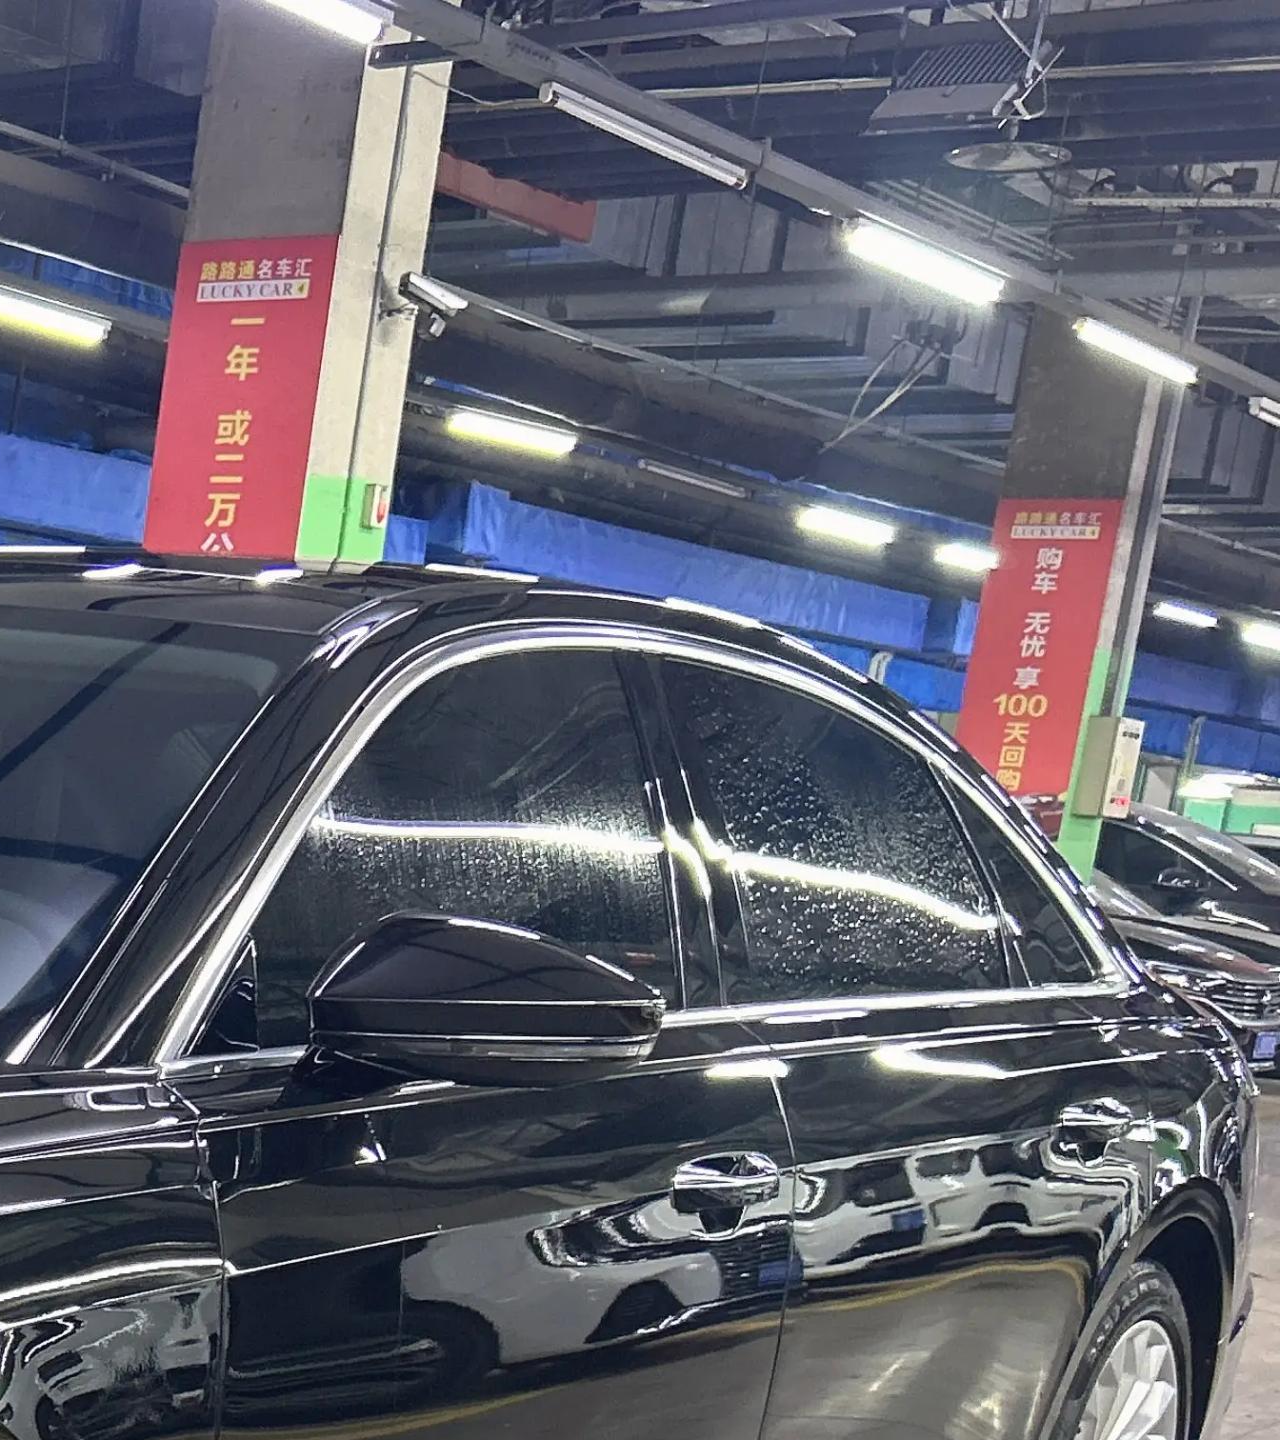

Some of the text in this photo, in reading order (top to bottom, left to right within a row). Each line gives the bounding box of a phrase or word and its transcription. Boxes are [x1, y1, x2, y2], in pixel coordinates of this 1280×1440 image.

[200, 258, 312, 281] 路路通名车汇
